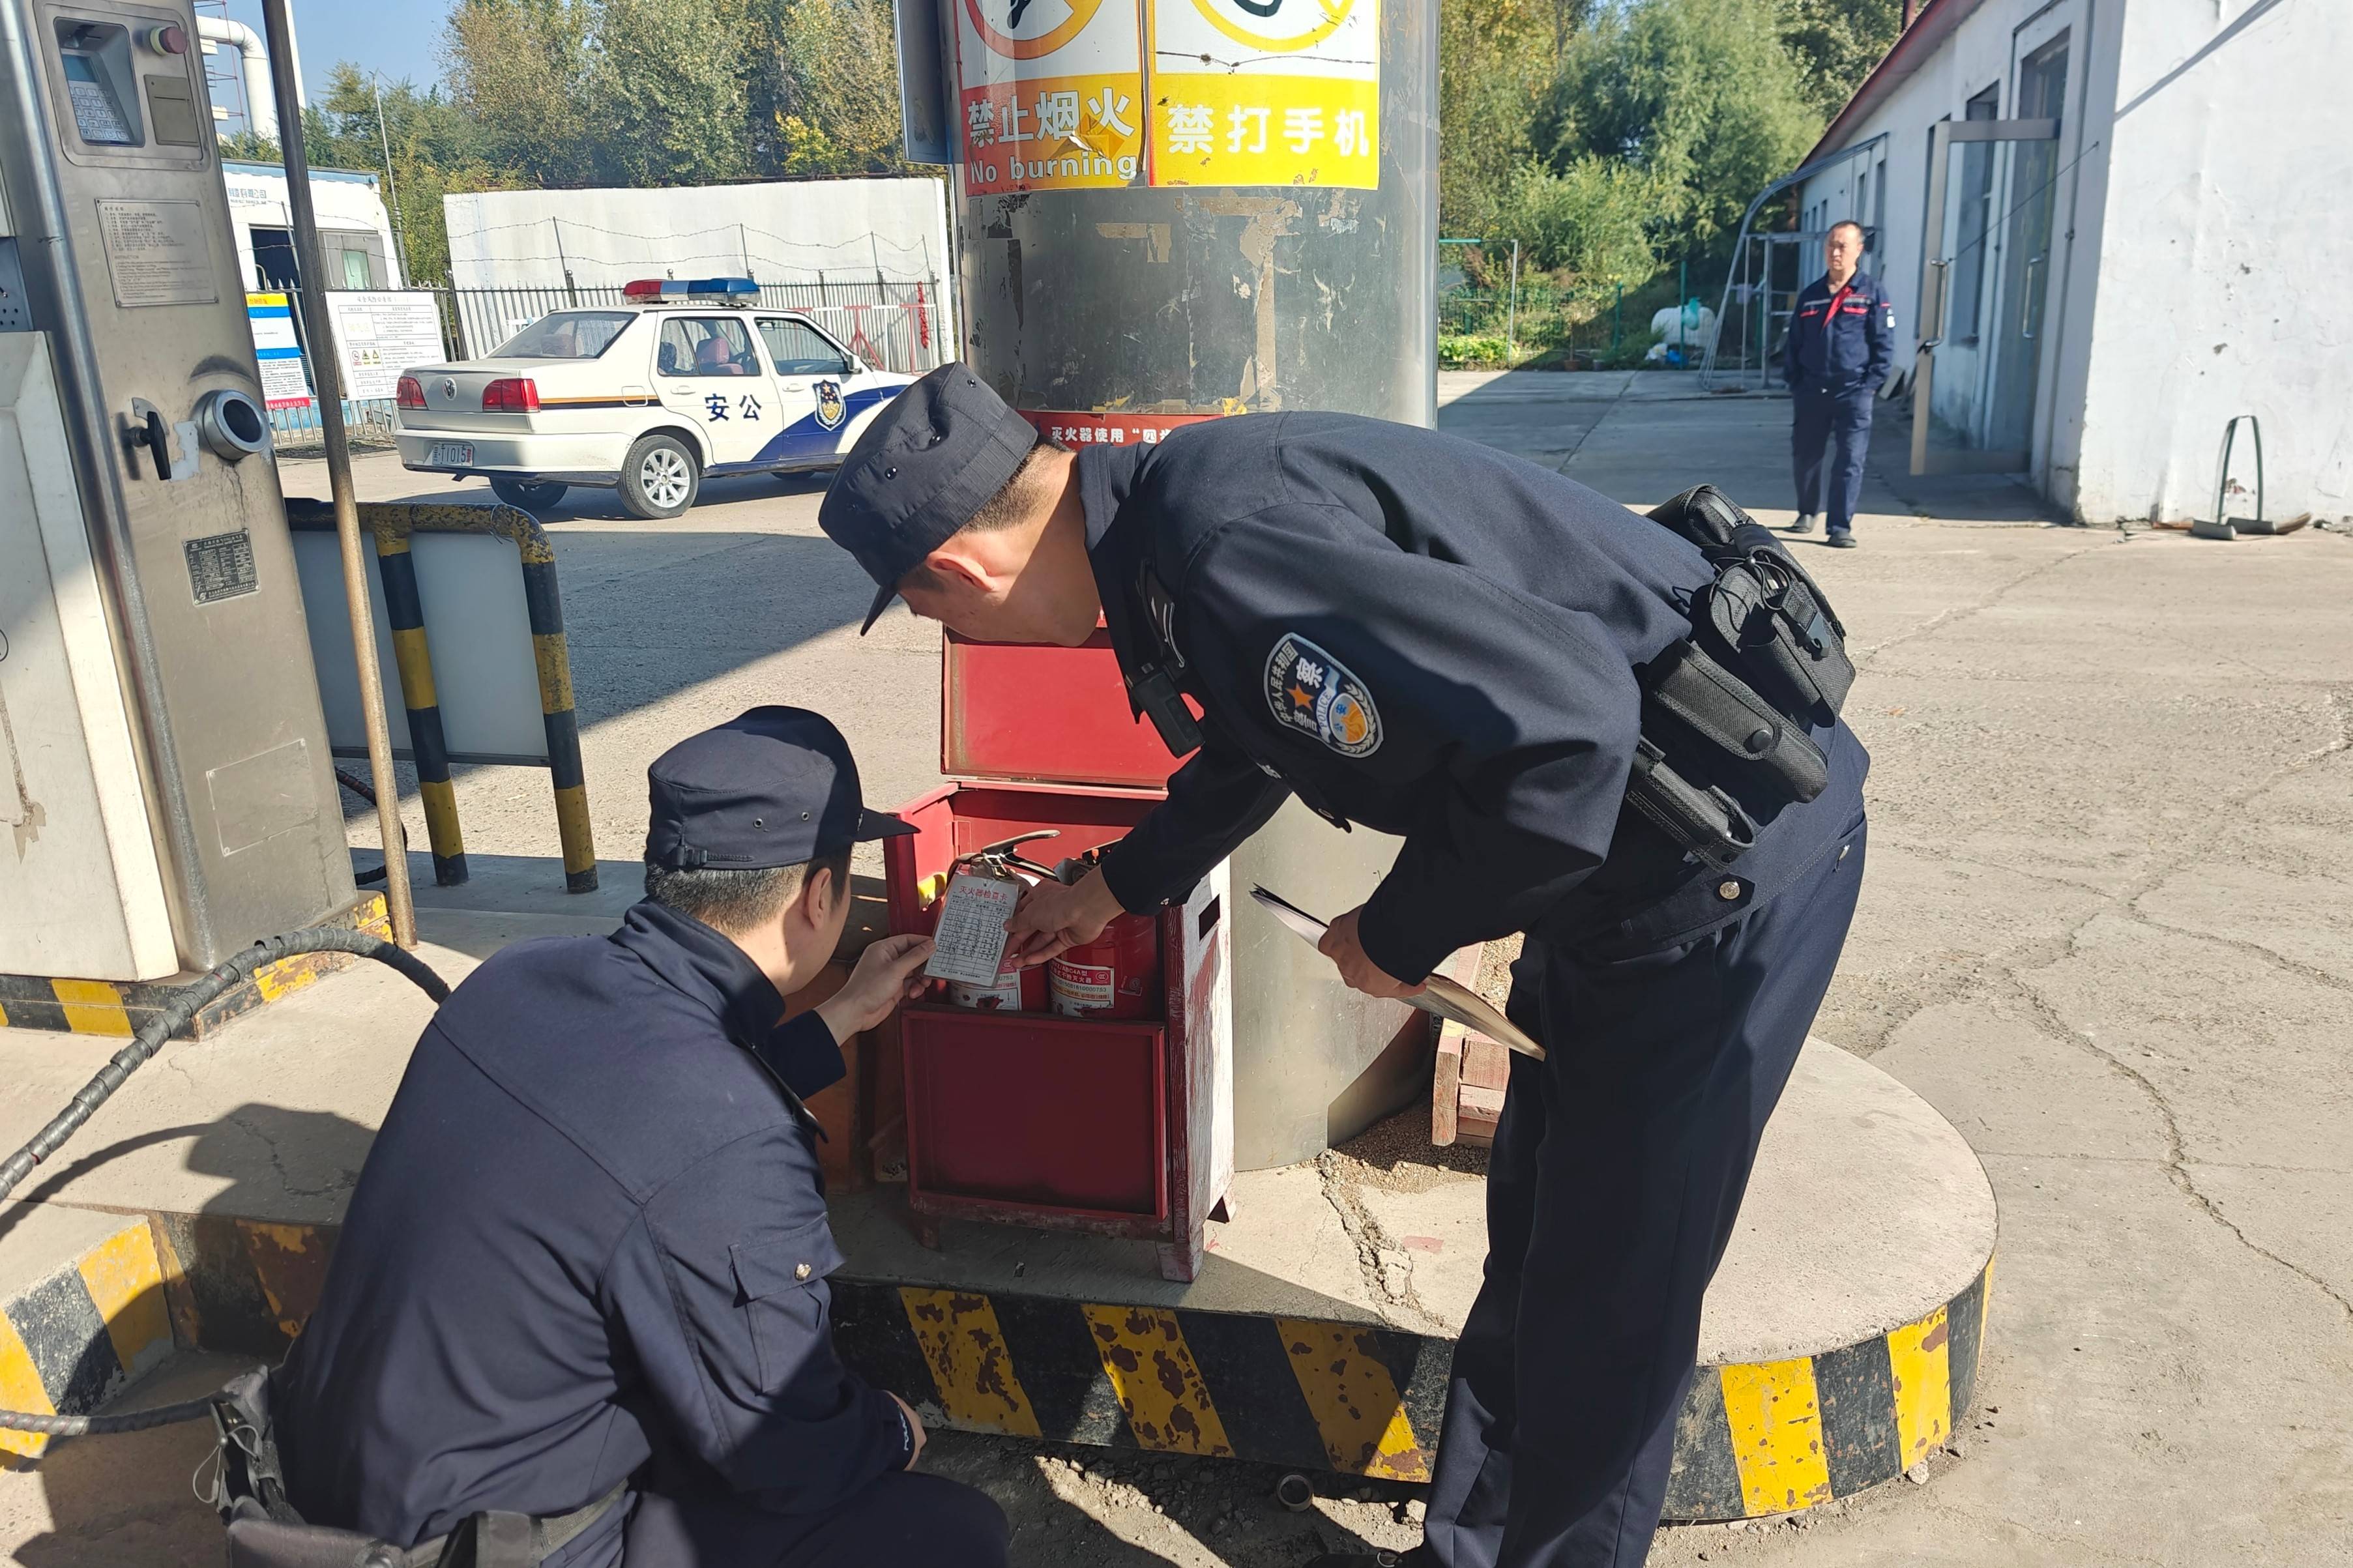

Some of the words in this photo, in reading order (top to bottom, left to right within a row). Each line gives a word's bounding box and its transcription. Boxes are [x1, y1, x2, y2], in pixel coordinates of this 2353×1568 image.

[968, 87, 1135, 148] 禁止烟火
[1167, 104, 1369, 157] 禁打手机
[971, 159, 997, 184] No
[1010, 151, 1137, 181] burning
[1319, 691, 1332, 729] POLICE
[959, 885, 1008, 901] 灭火器检查卡
